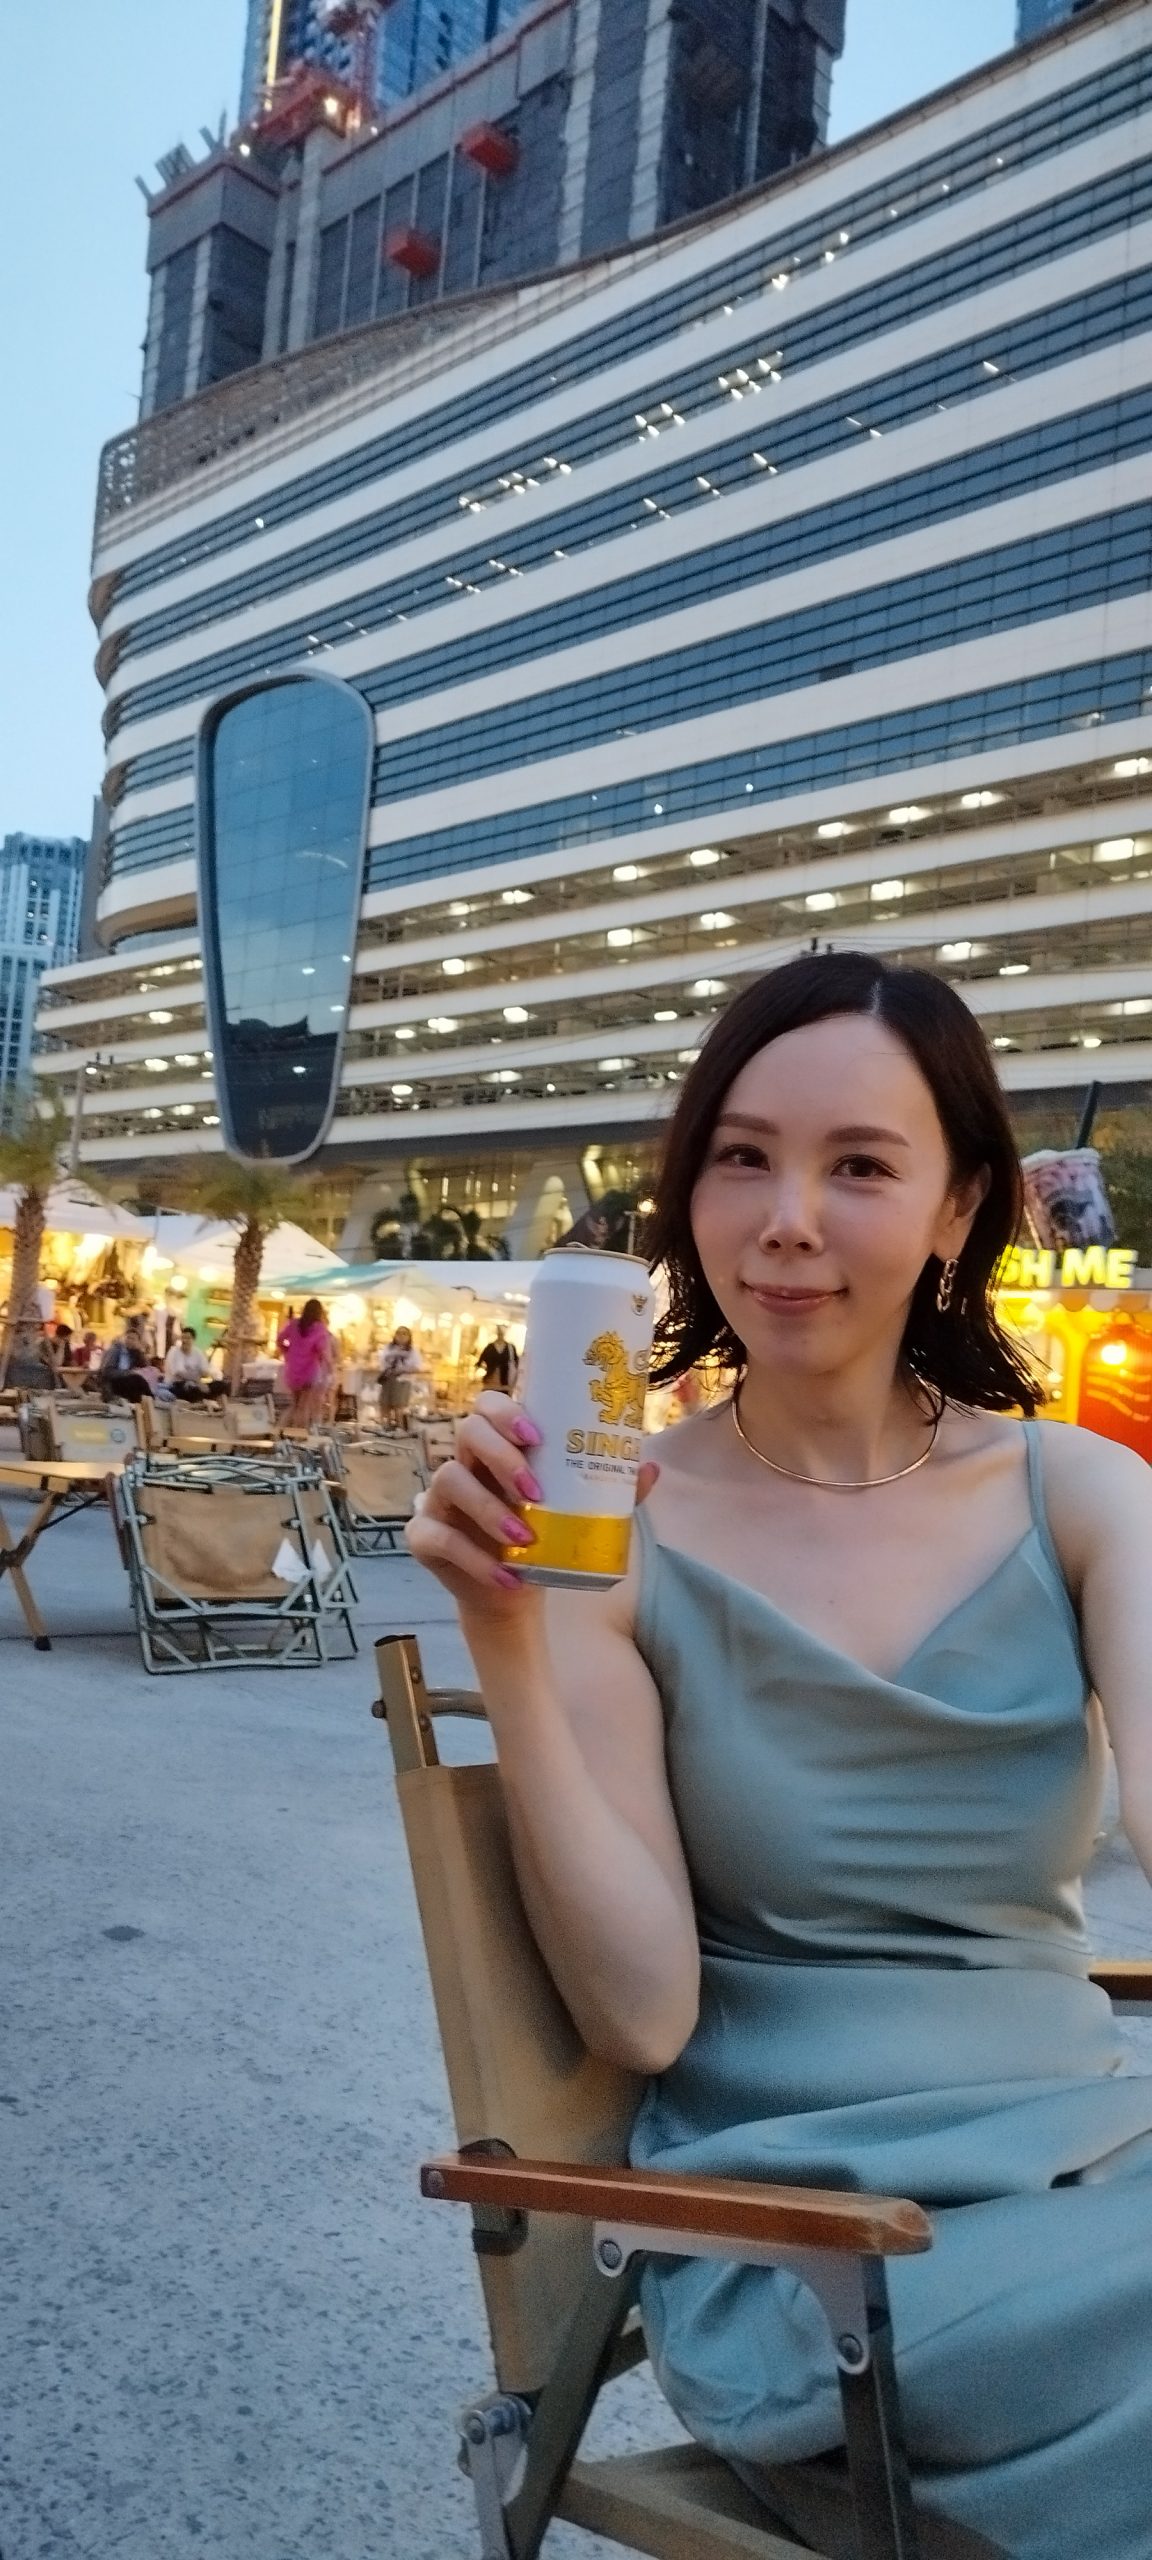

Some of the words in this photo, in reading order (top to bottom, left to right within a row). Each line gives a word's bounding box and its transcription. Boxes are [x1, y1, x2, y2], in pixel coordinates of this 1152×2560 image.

[997, 1243, 1052, 1288] SH
[1061, 1244, 1138, 1289] ME
[565, 1458, 585, 1469] THE
[588, 1461, 625, 1475] ORIGINAL
